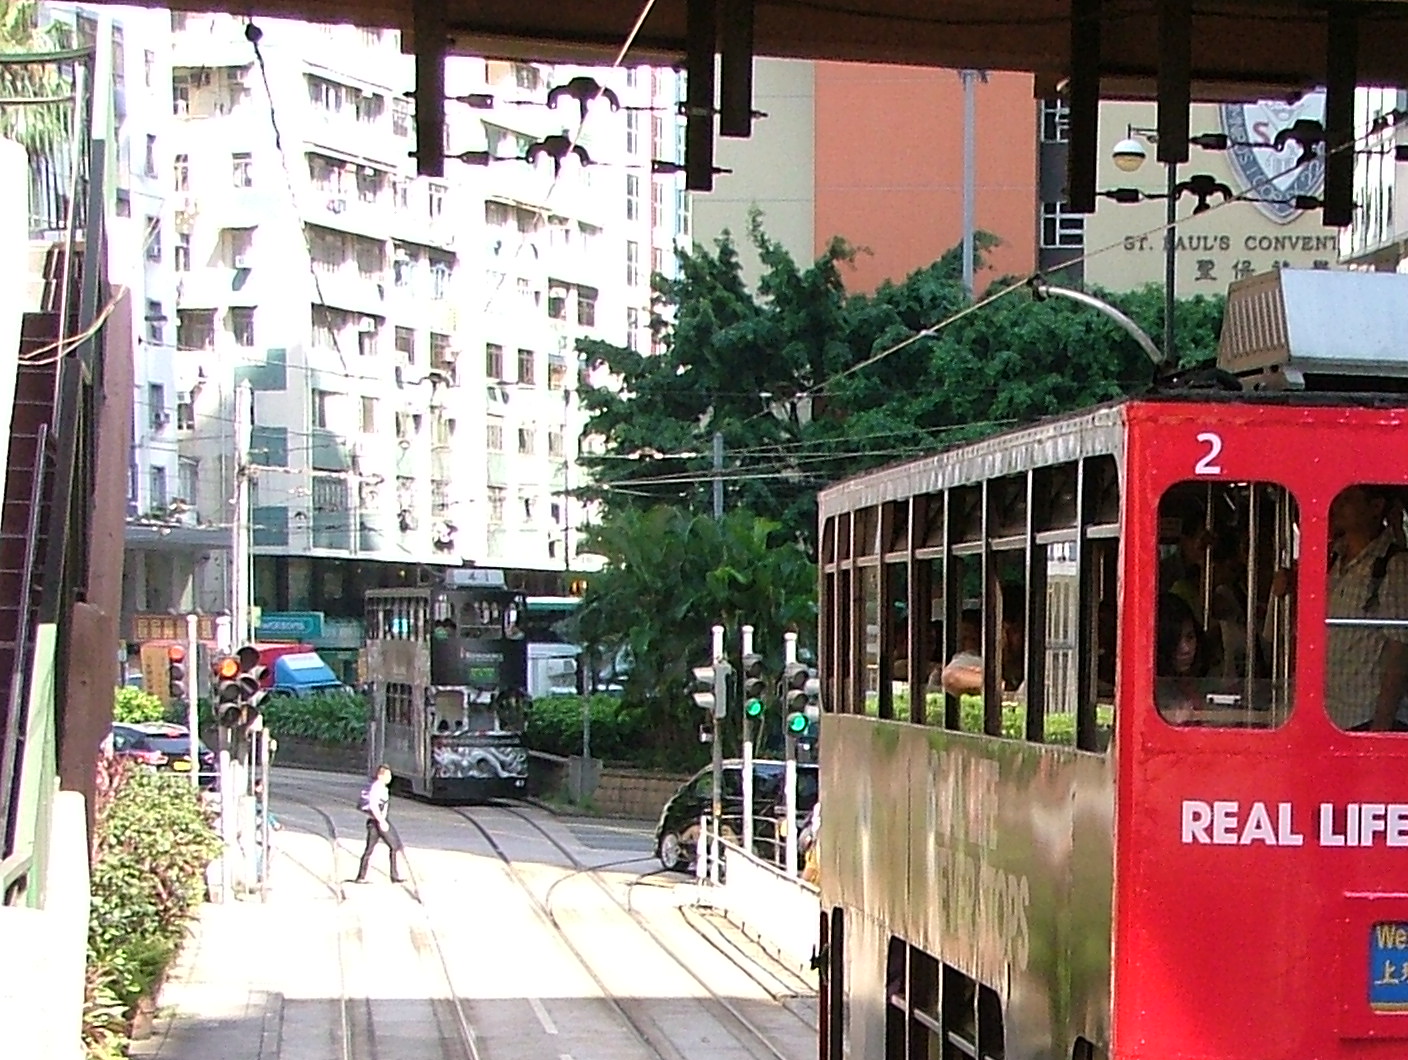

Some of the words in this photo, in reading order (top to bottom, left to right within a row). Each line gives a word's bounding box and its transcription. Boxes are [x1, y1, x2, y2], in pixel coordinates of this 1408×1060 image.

[1124, 236, 1153, 251] ST.
[1163, 235, 1230, 251] AUL'S
[1194, 432, 1223, 475] 2
[1182, 801, 1303, 846] REAL
